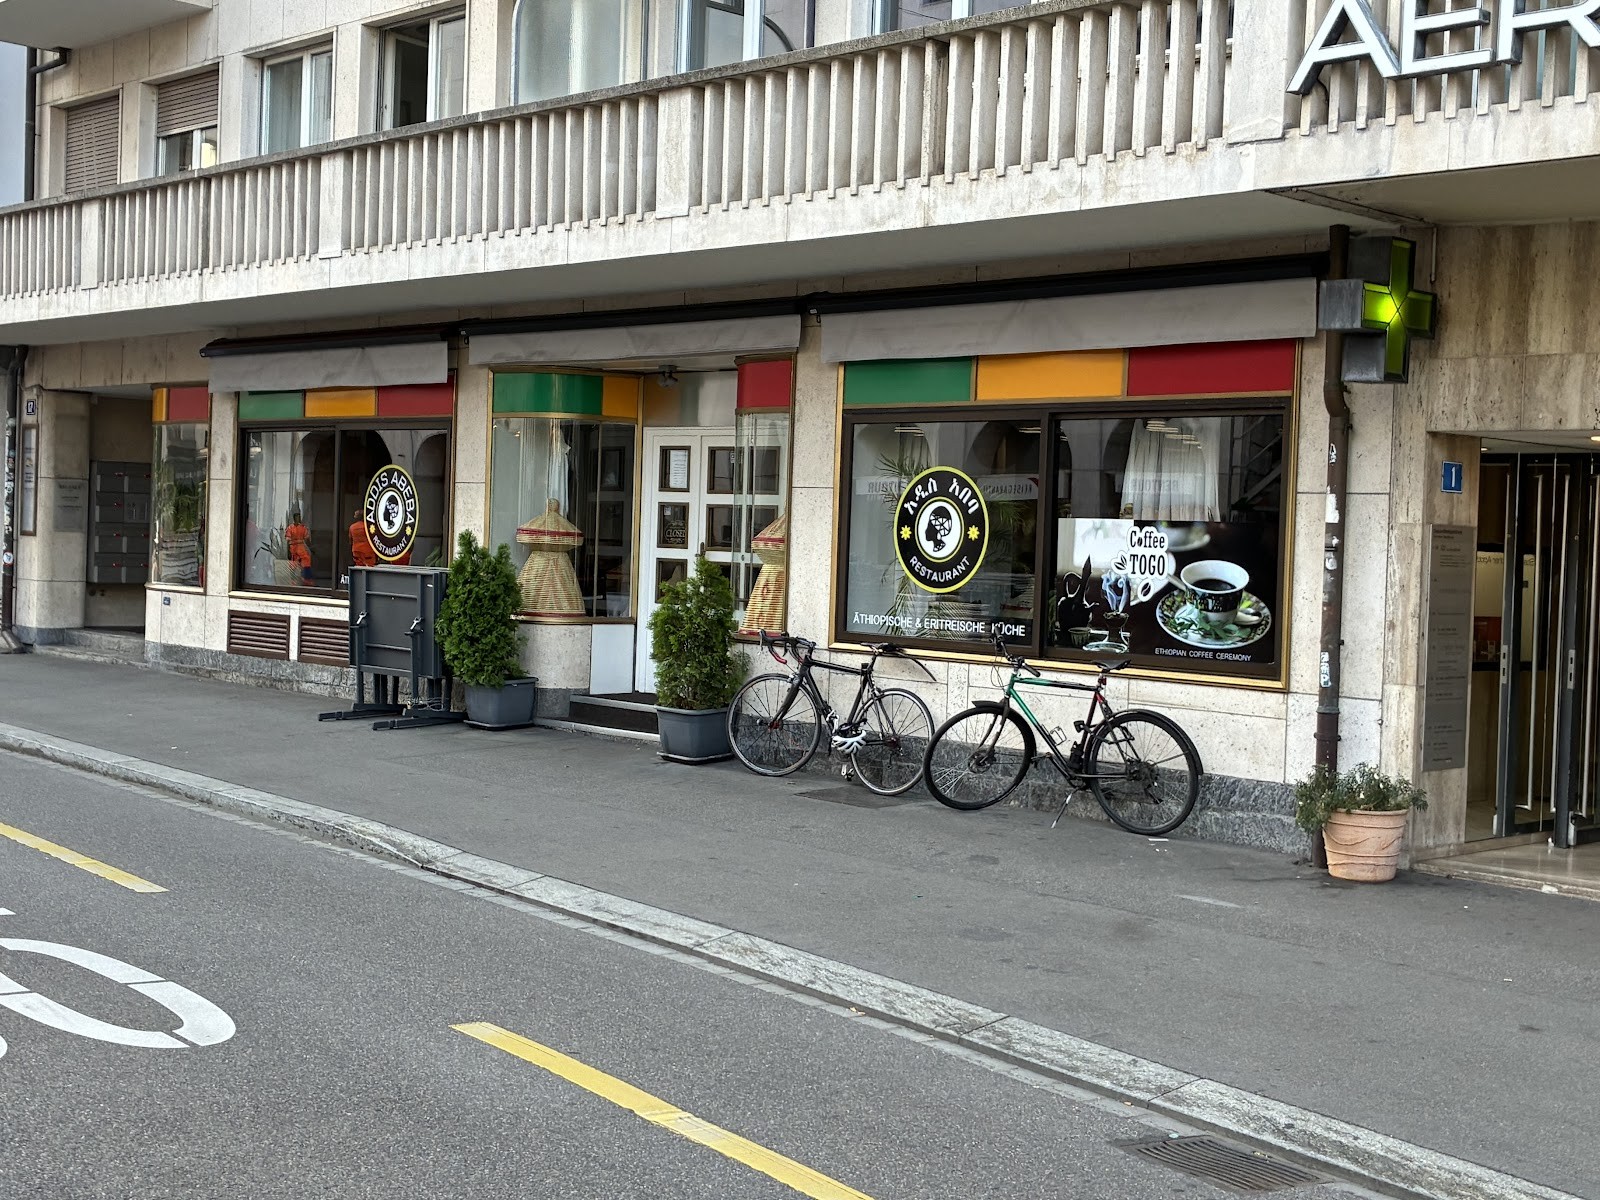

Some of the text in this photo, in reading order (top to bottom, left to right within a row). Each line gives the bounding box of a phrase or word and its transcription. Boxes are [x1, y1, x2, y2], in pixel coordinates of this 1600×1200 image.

[1451, 466, 1456, 488] 1
[366, 471, 415, 524] ADDIS ABEBA
[373, 535, 408, 556] RESTAURANT
[1130, 531, 1165, 549] Coffee
[909, 555, 971, 582] RESTAURANT
[1130, 554, 1165, 576] TOGO
[853, 612, 913, 628] ÄTHIOPISCHE
[915, 618, 922, 628] &
[925, 618, 985, 633] ERITREISCHE
[1155, 647, 1251, 662] ETHIOPIAN COFFEE CEREMONY
